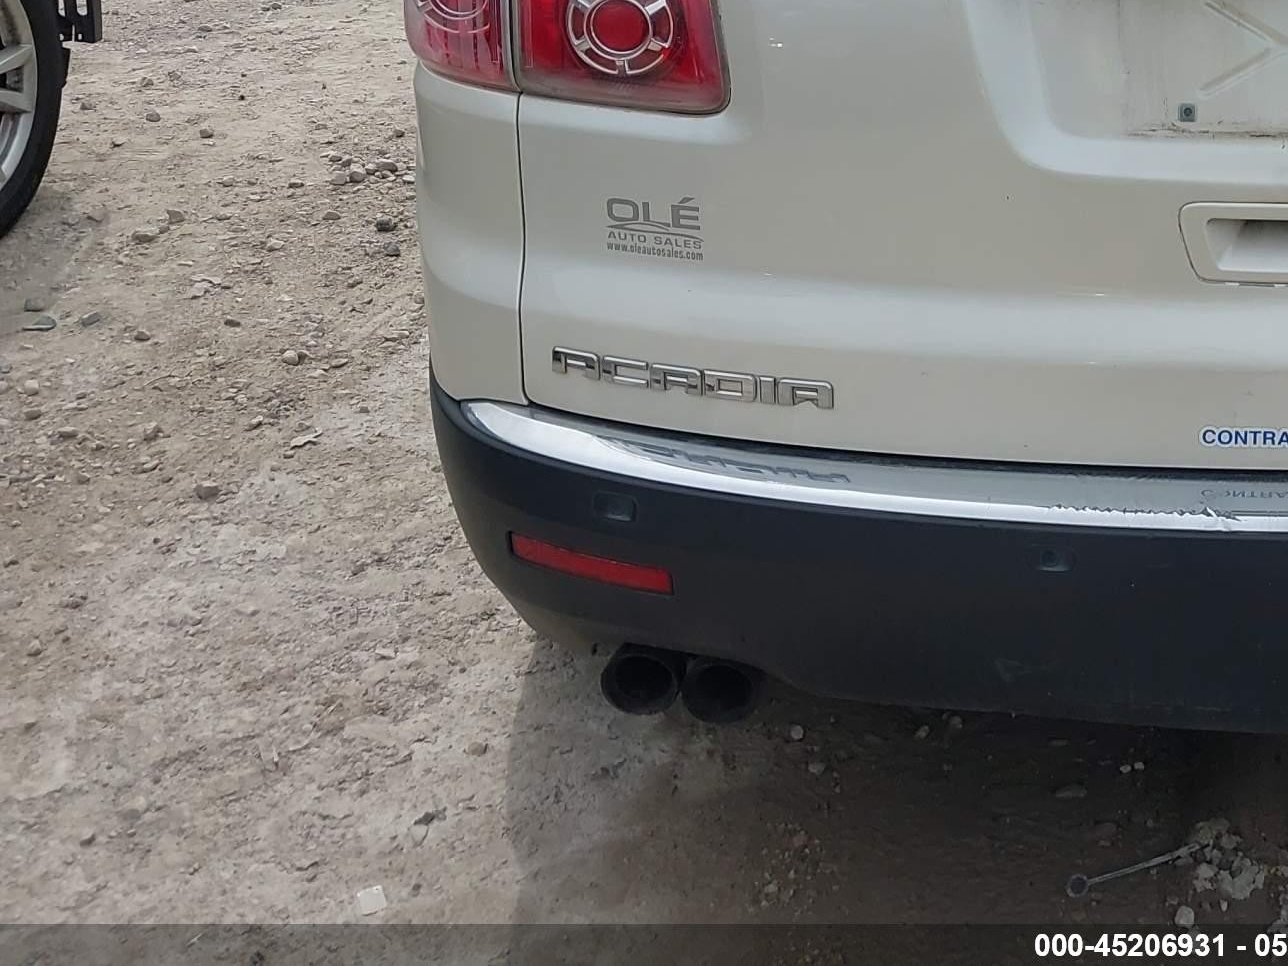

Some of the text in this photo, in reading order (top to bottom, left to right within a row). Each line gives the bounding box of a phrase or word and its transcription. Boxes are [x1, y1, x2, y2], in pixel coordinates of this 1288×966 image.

[606, 196, 701, 231] OLÉ
[606, 242, 704, 261] www.oleautosales.com
[607, 231, 702, 250] AUTO SALES
[552, 345, 834, 409] ACADIA
